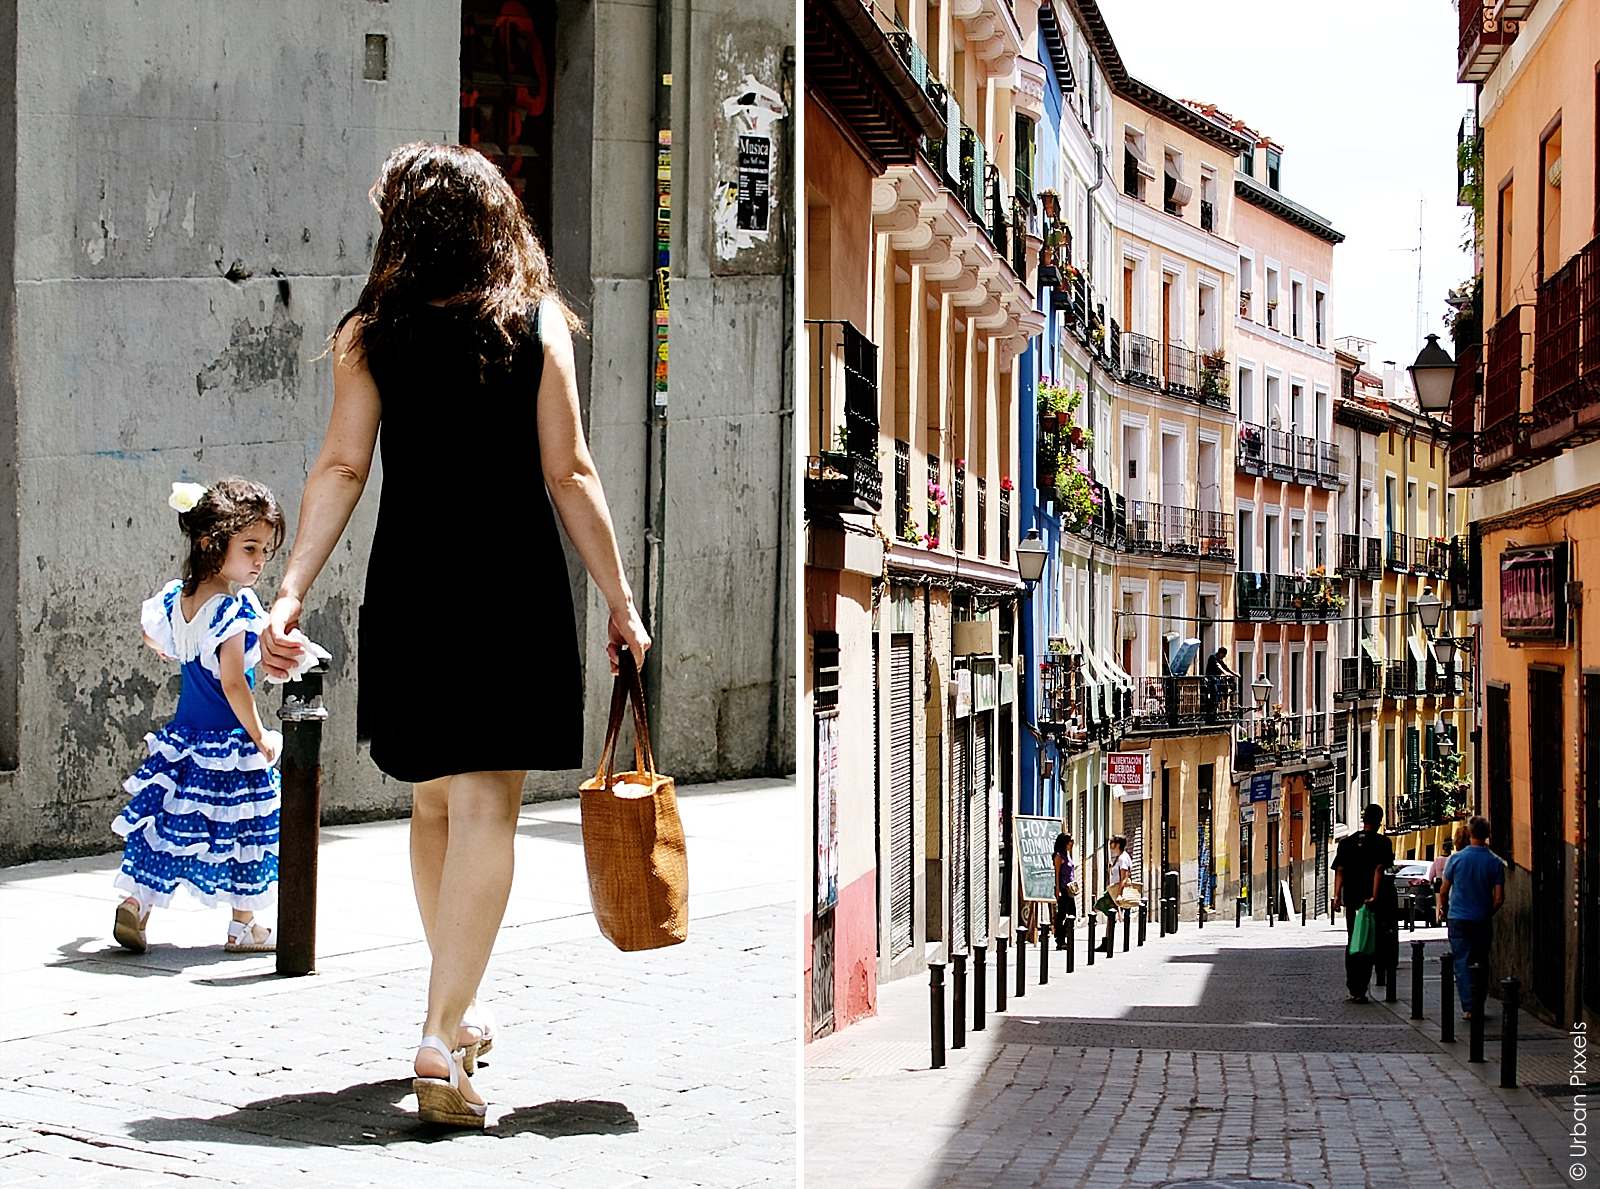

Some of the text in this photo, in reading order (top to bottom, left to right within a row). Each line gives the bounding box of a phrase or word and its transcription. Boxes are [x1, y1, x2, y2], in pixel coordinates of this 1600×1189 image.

[1114, 765, 1136, 773] BEBIDAS
[1109, 774, 1141, 783] FRUTOS SECOS
[1020, 821, 1048, 838] HOY
